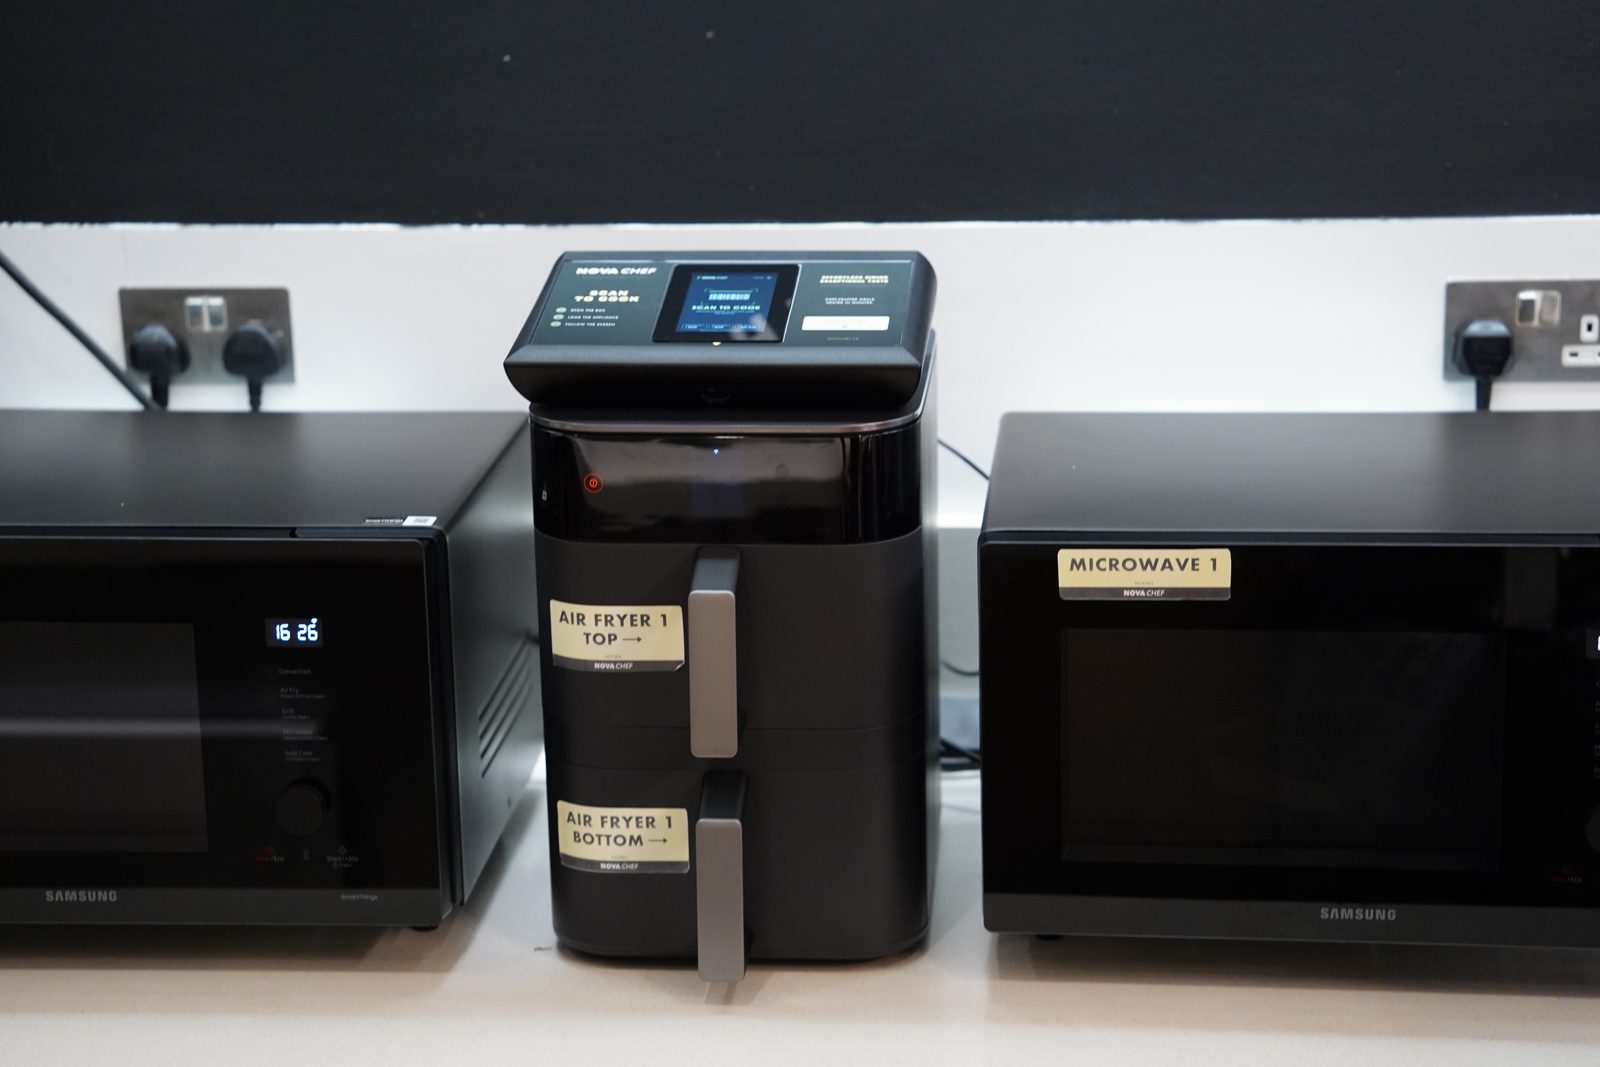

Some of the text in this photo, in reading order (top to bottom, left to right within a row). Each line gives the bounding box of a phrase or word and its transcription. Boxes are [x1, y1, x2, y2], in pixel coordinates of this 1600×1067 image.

[576, 267, 657, 275] NOVA CHEF
[1069, 557, 1217, 572] MICROWAVE 1
[559, 610, 667, 627] AIR FRYER 1
[276, 624, 318, 641] 16 26
[583, 632, 618, 645] TOP
[566, 812, 672, 829] AIR FRYER 1
[573, 832, 644, 846] BOTTOM
[46, 890, 118, 902] SAMSUNG
[1320, 908, 1396, 920] SAMSUNG
